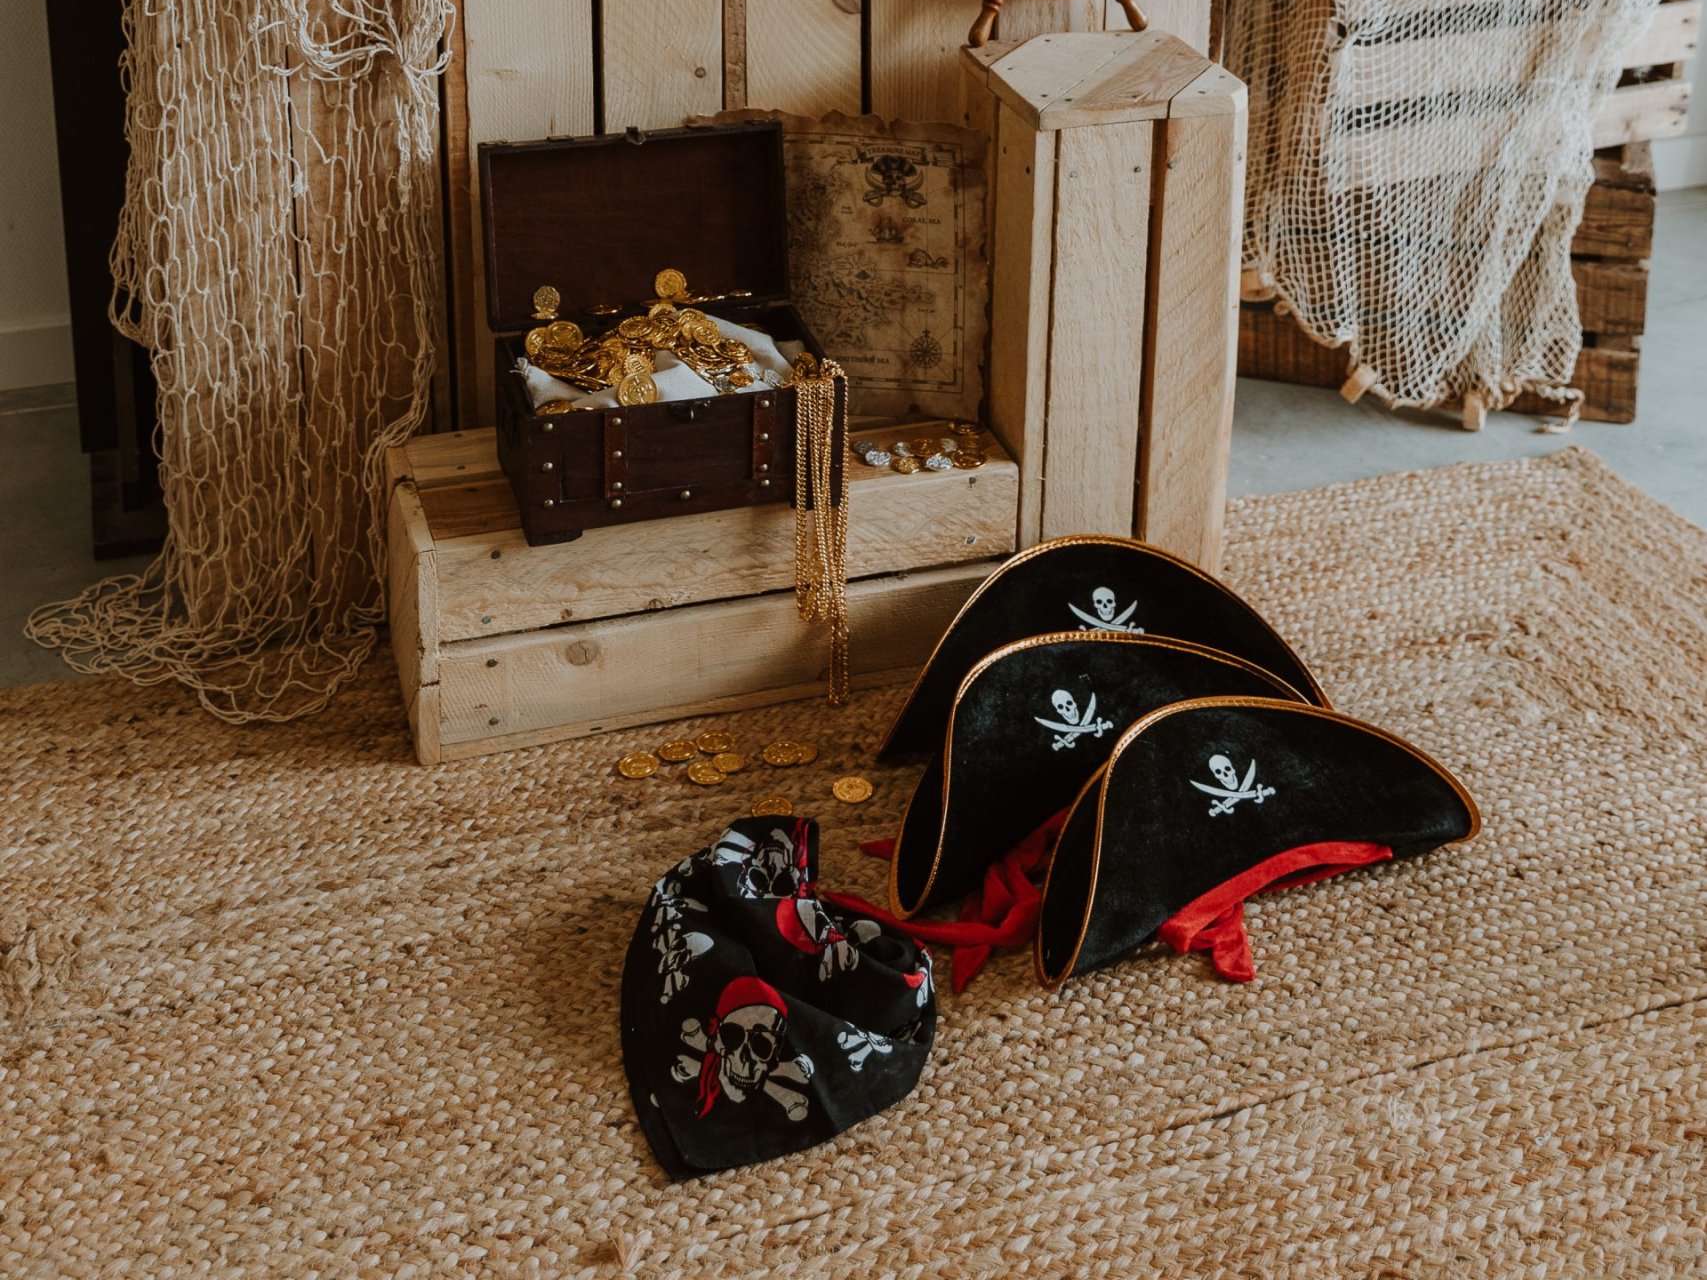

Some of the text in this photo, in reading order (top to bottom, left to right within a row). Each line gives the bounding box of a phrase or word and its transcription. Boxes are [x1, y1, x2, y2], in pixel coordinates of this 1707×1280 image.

[867, 146, 921, 157] TREASURE MAP
[902, 216, 926, 224] CORAL
